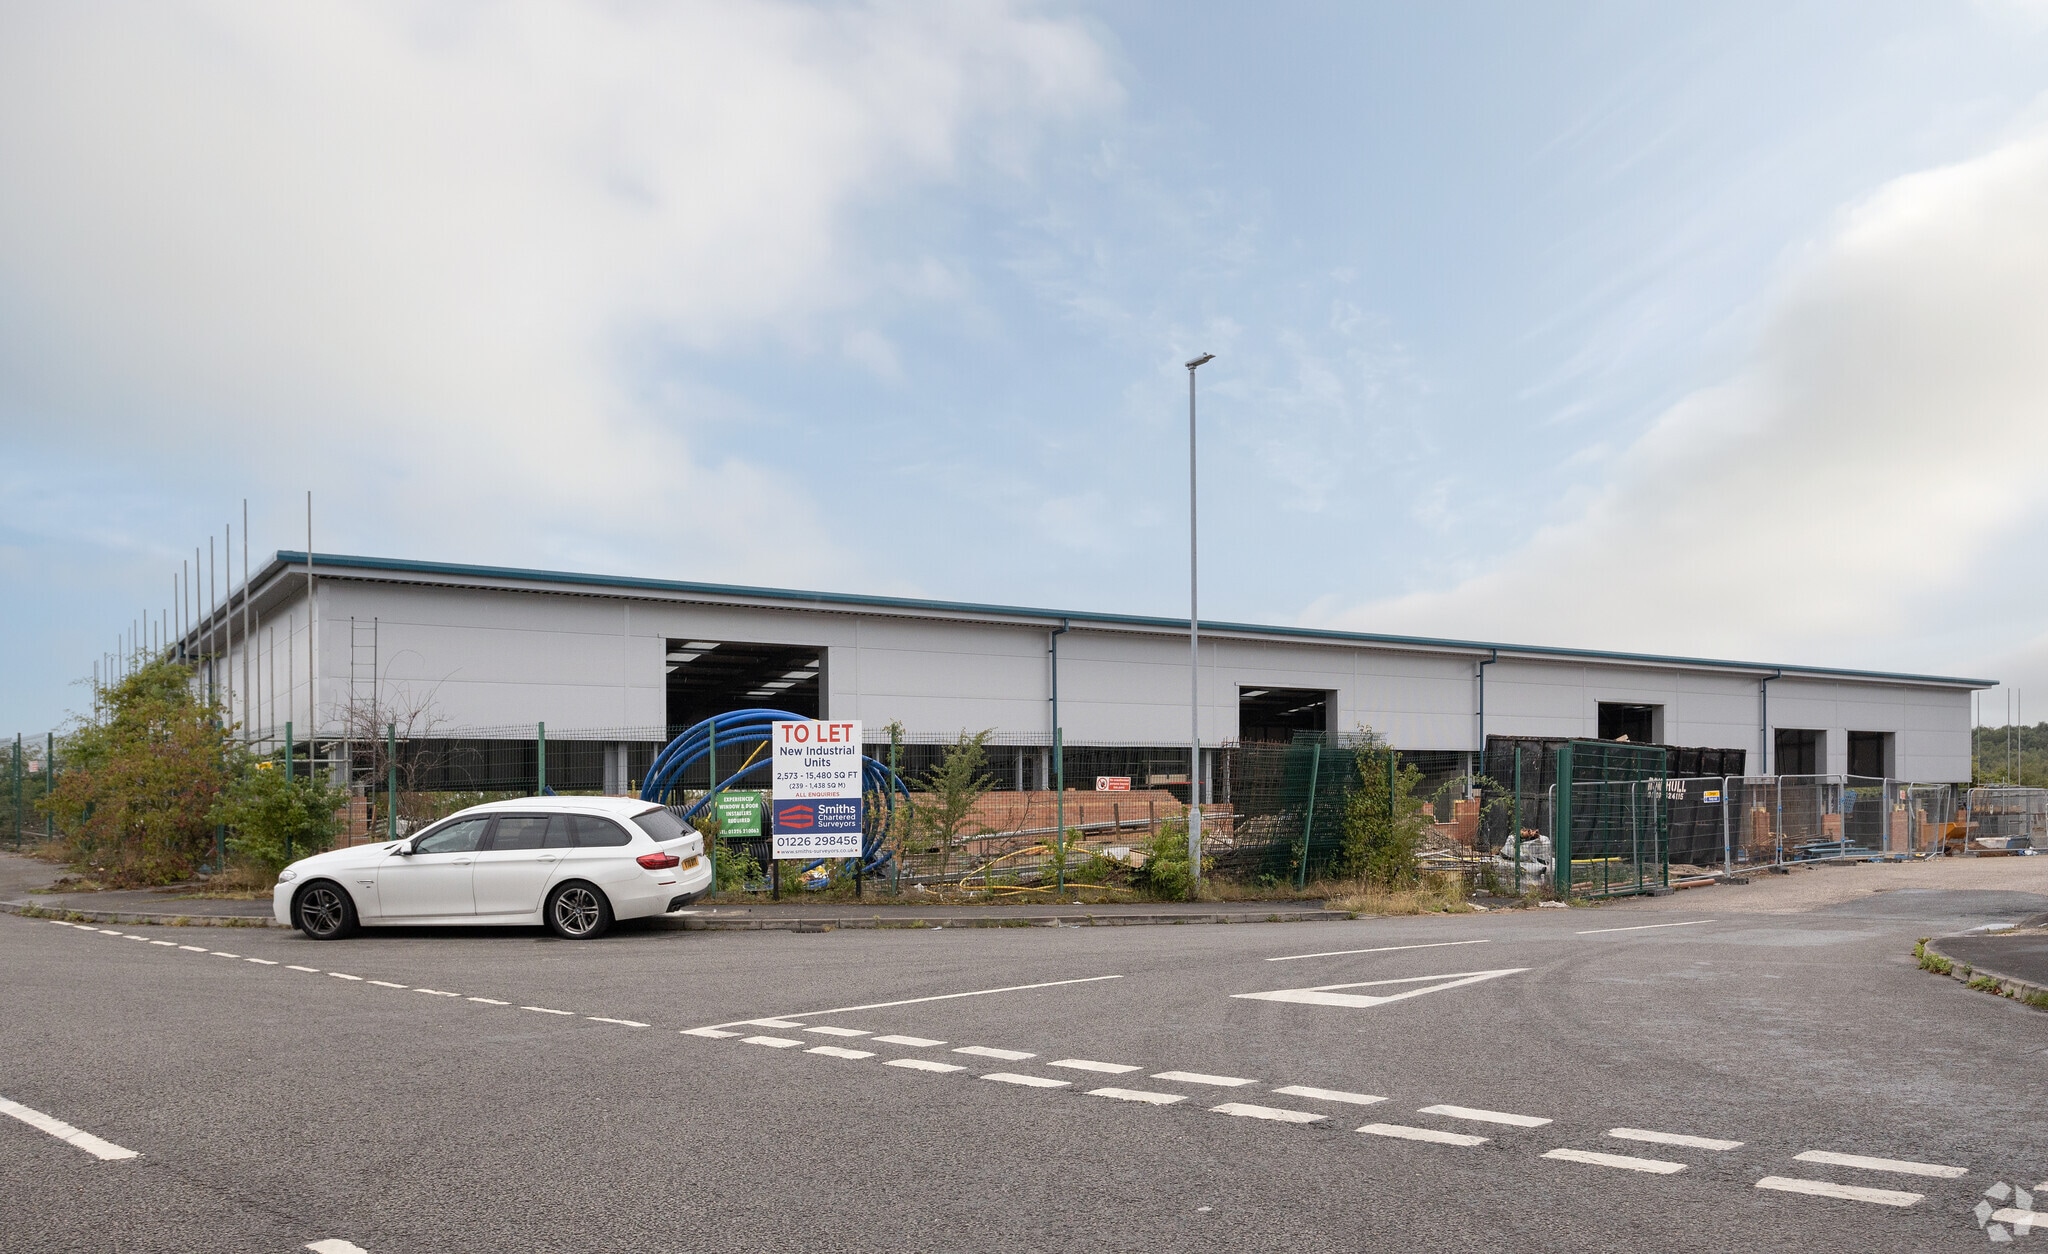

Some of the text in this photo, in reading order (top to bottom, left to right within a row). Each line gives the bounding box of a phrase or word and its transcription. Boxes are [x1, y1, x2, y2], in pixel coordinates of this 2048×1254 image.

[781, 724, 854, 743] TO LET
[780, 745, 855, 756] New Industrial
[804, 758, 831, 767] Units
[777, 772, 799, 780] 2,573
[805, 771, 832, 780] 15,480
[834, 771, 846, 779] SQ
[847, 771, 858, 779] FT
[789, 782, 804, 790] (239
[1665, 780, 1686, 792] HULL
[818, 804, 856, 814] Smiths
[777, 836, 858, 847] 01226 298456
